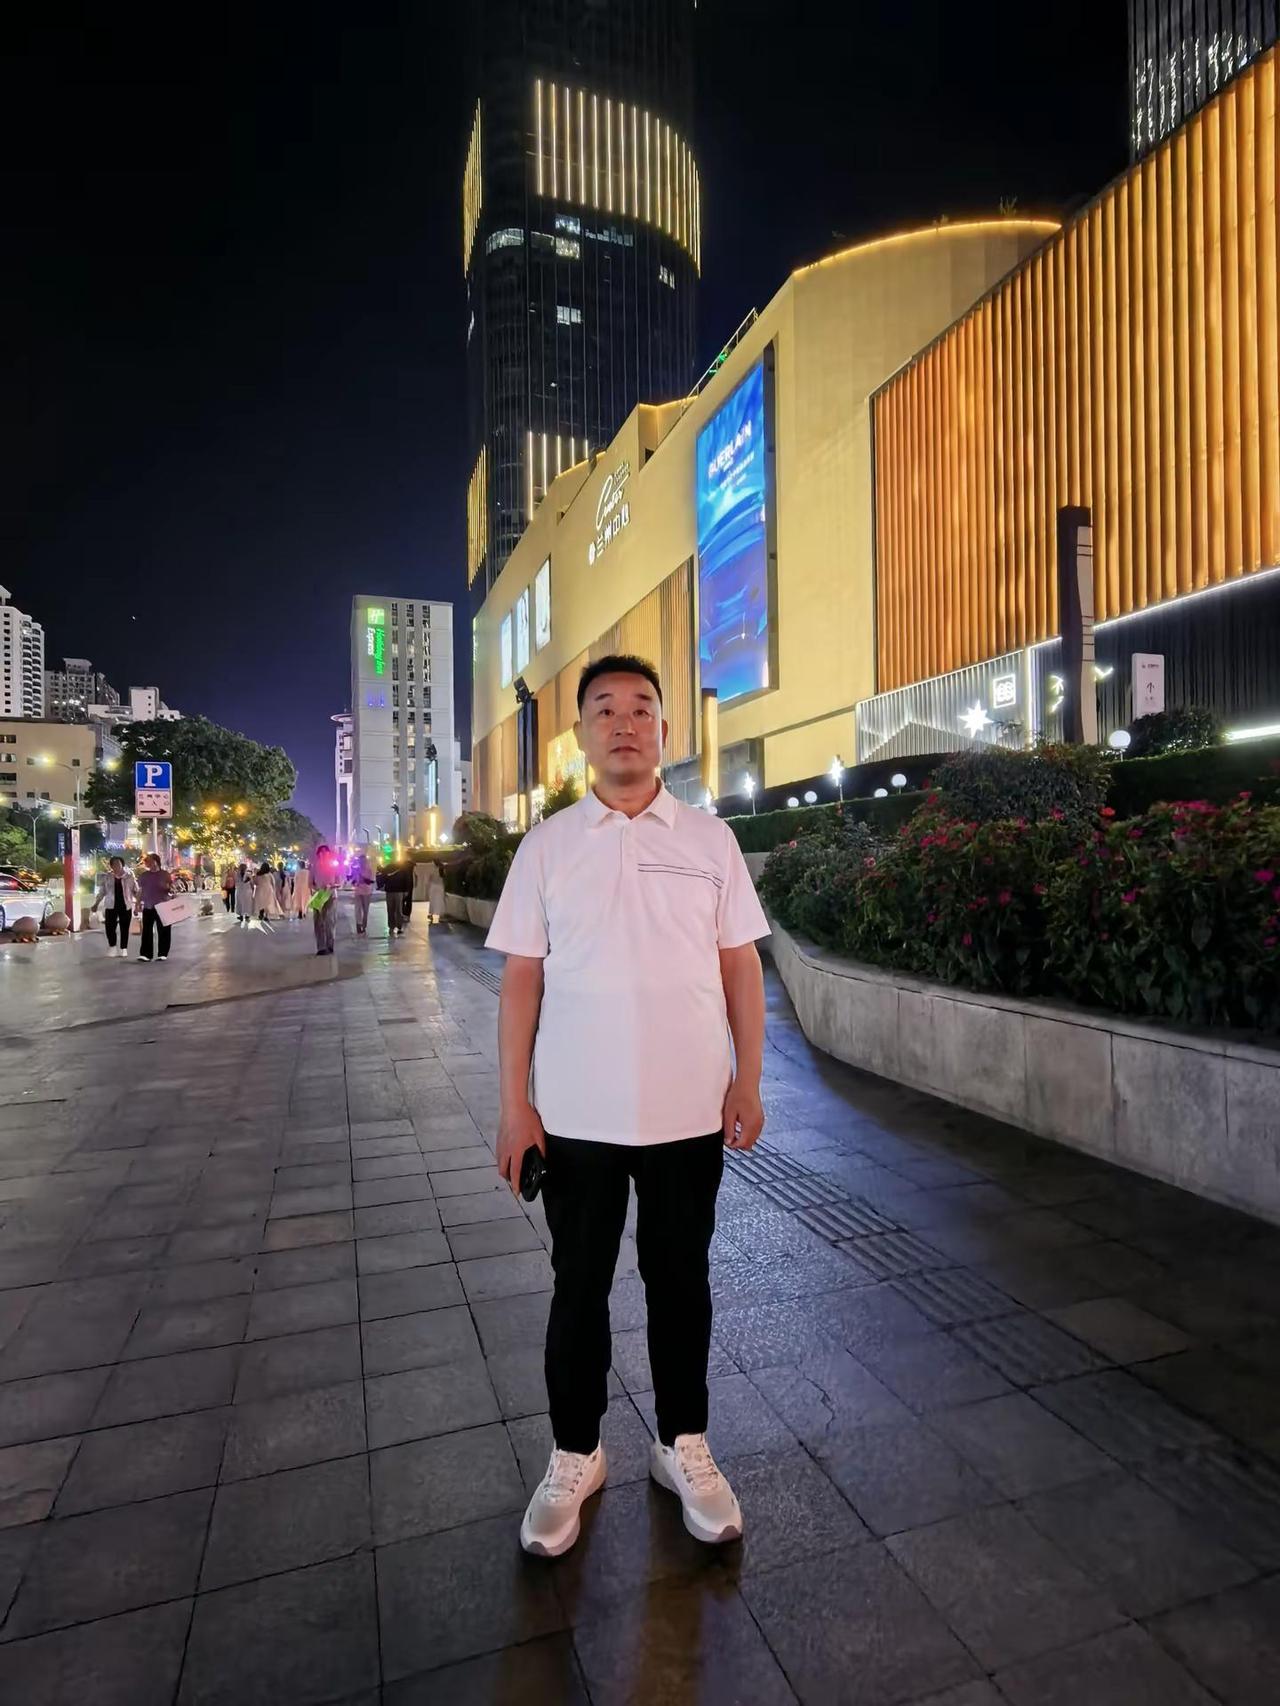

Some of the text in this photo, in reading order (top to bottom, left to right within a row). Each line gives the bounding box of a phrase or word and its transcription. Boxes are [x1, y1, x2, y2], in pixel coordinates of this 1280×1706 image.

[367, 627, 375, 656] Express
[374, 628, 385, 674] Holiday Inn
[144, 764, 163, 787] P
